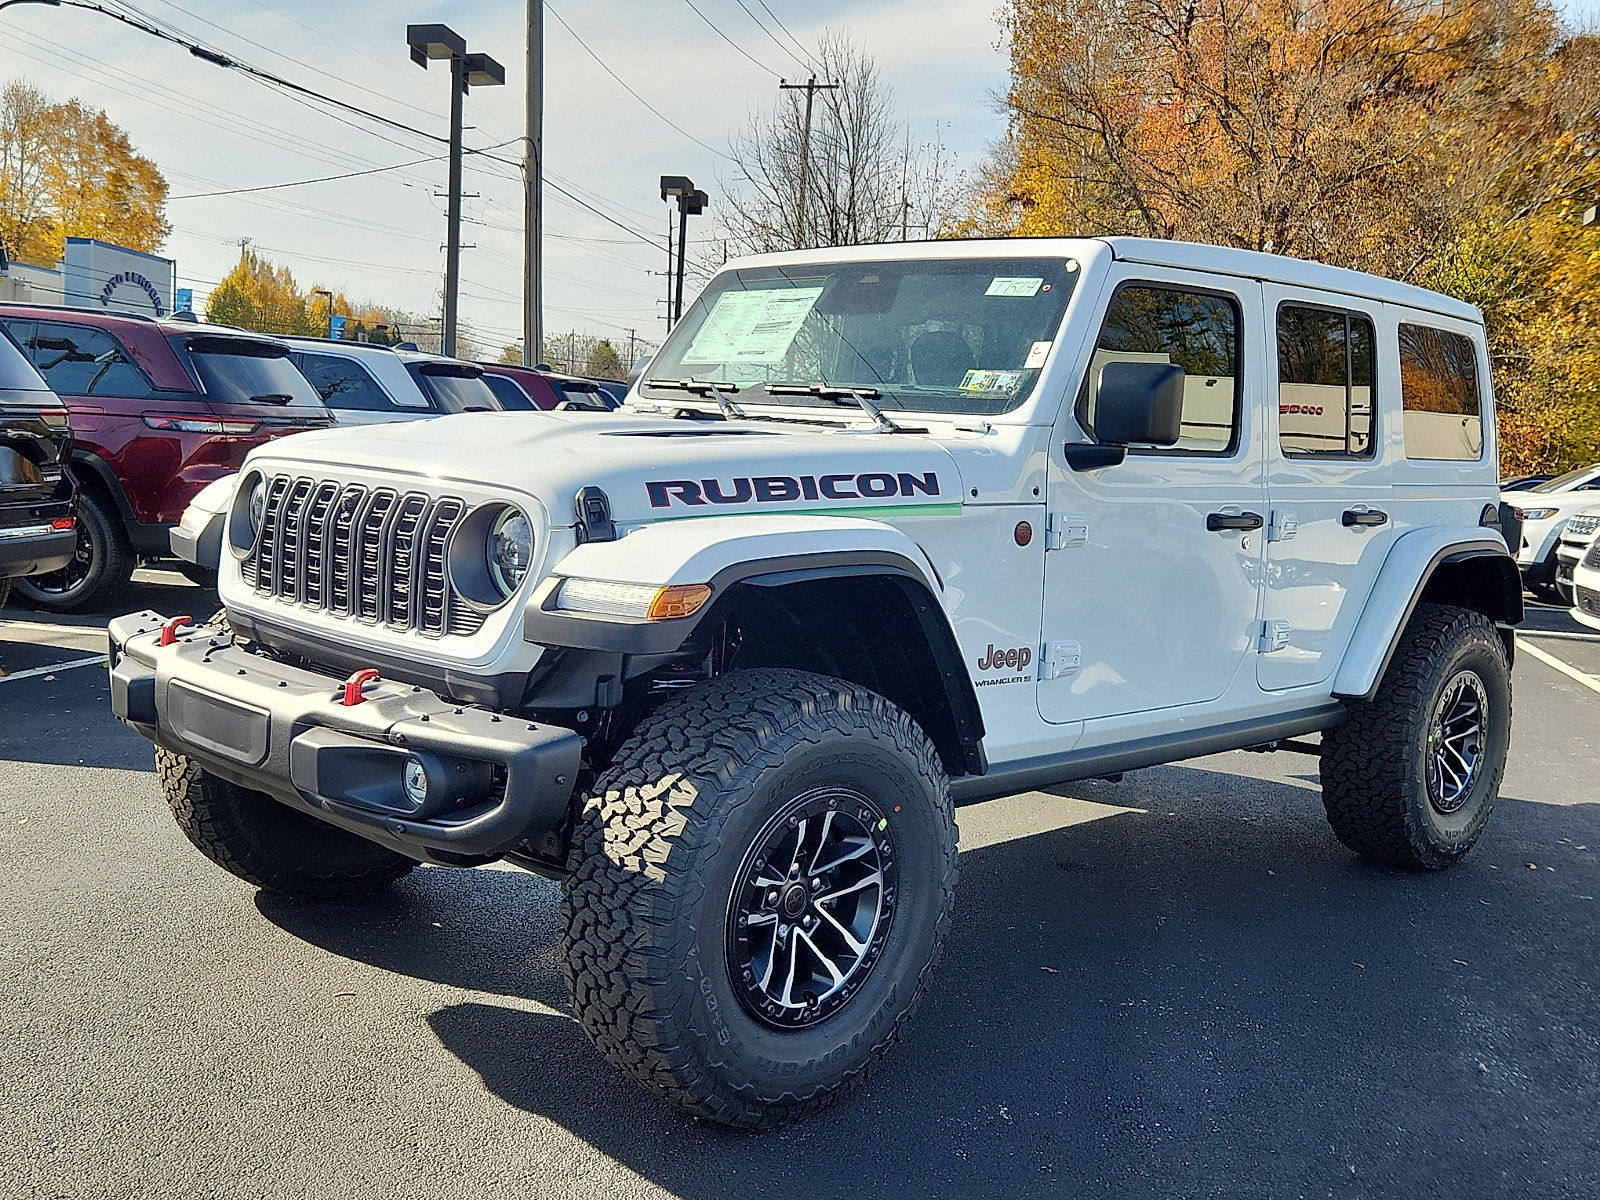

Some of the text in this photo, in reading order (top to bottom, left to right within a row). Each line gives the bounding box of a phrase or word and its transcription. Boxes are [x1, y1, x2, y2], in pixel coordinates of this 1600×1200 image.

[645, 472, 941, 508] RUBICON
[977, 644, 1032, 671] Jeep
[975, 677, 1023, 687] WRANGLER
